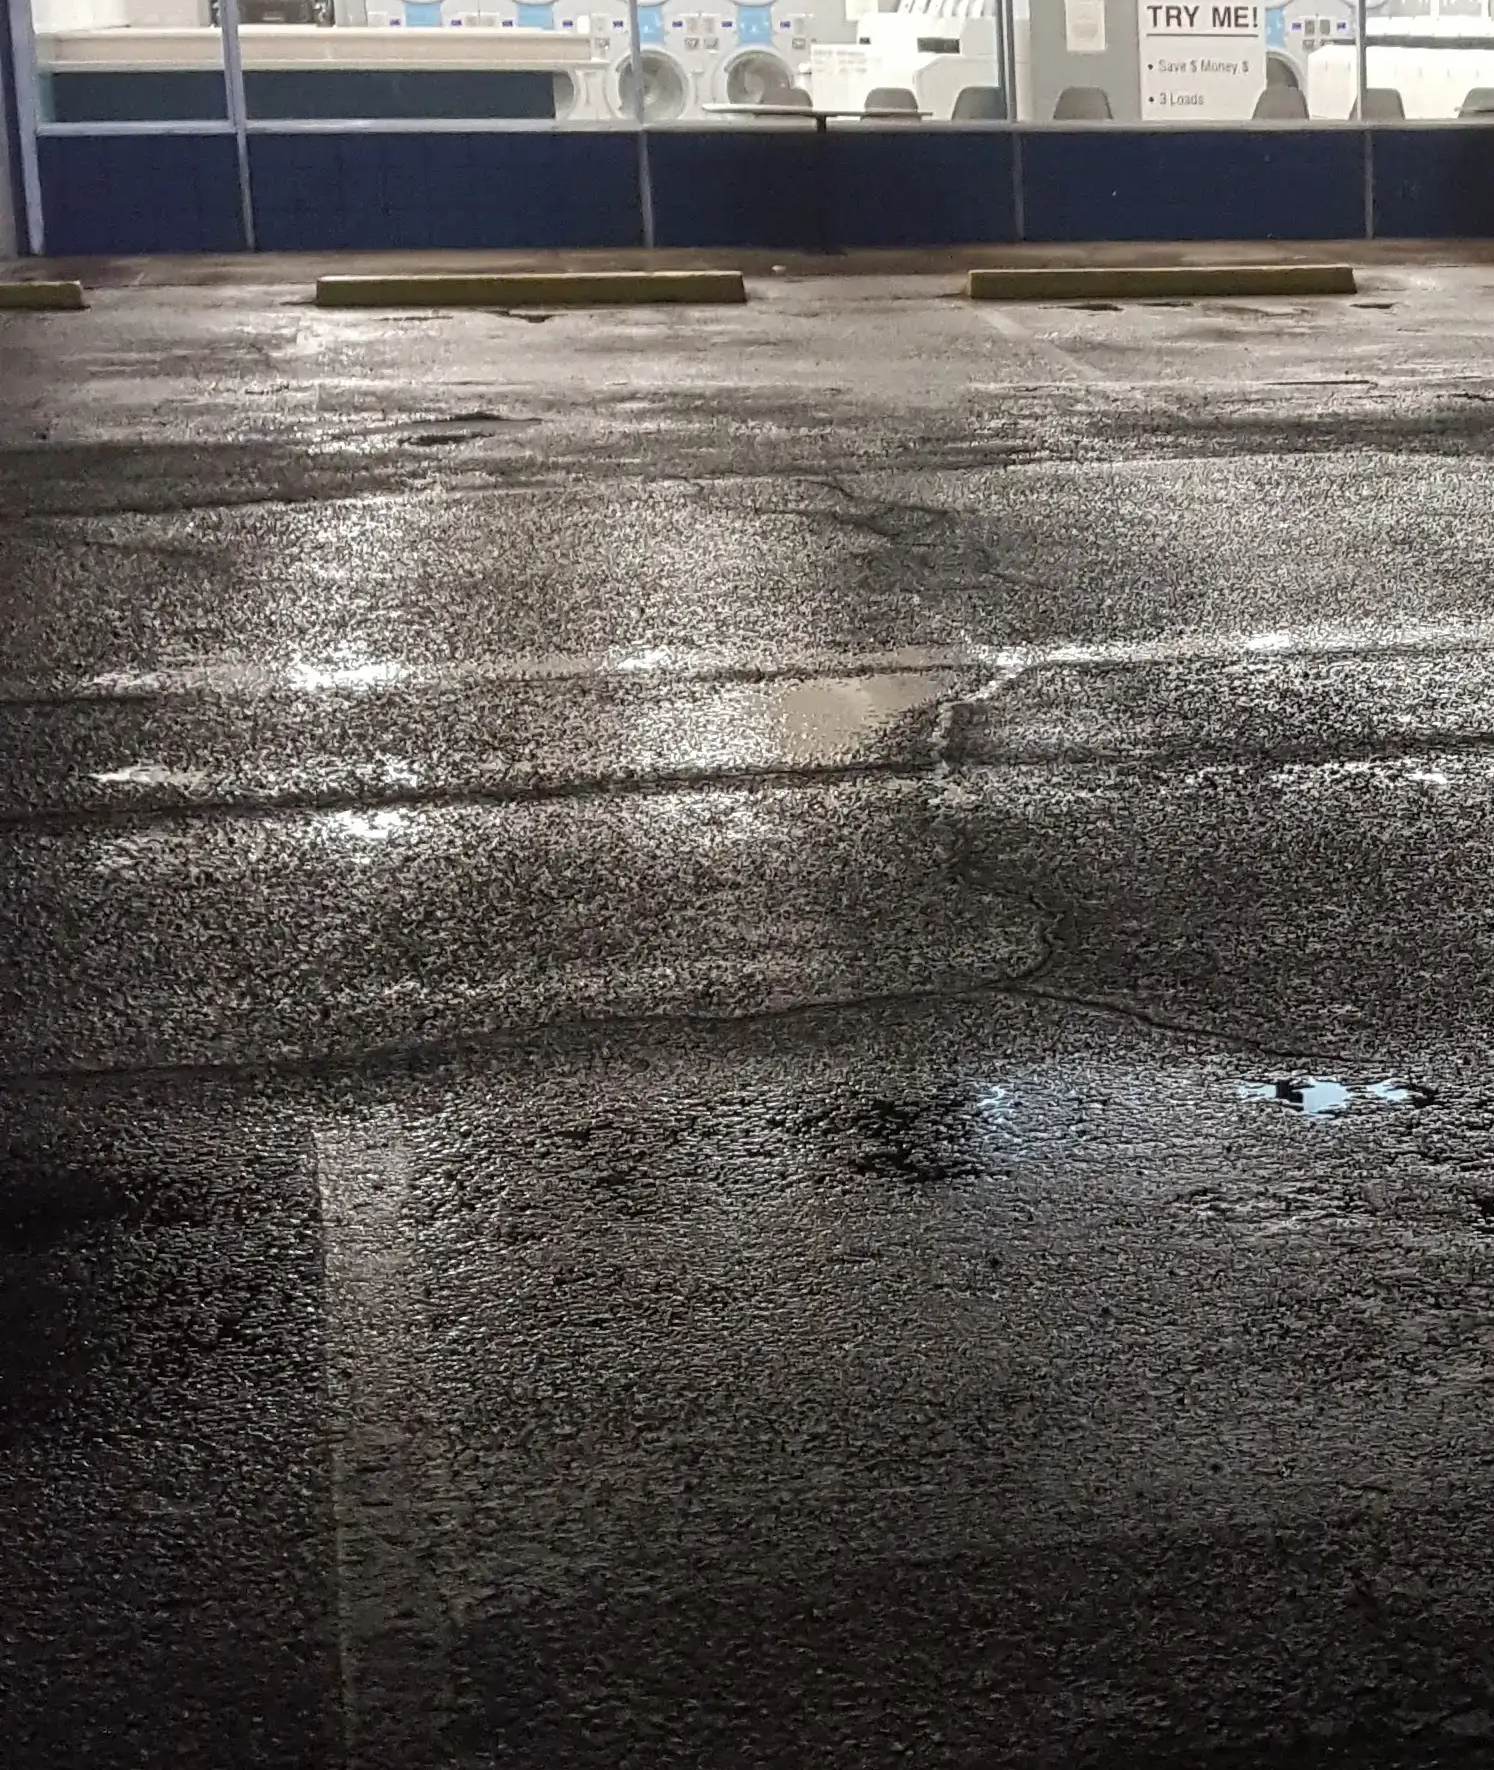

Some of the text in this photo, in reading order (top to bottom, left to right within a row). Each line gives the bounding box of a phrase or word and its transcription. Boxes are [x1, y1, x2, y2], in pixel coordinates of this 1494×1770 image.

[1146, 5, 1258, 28] TRY ME!
[1158, 59, 1186, 73] Save
[1200, 59, 1238, 75] Money
[1160, 92, 1205, 107] 3 Loads
